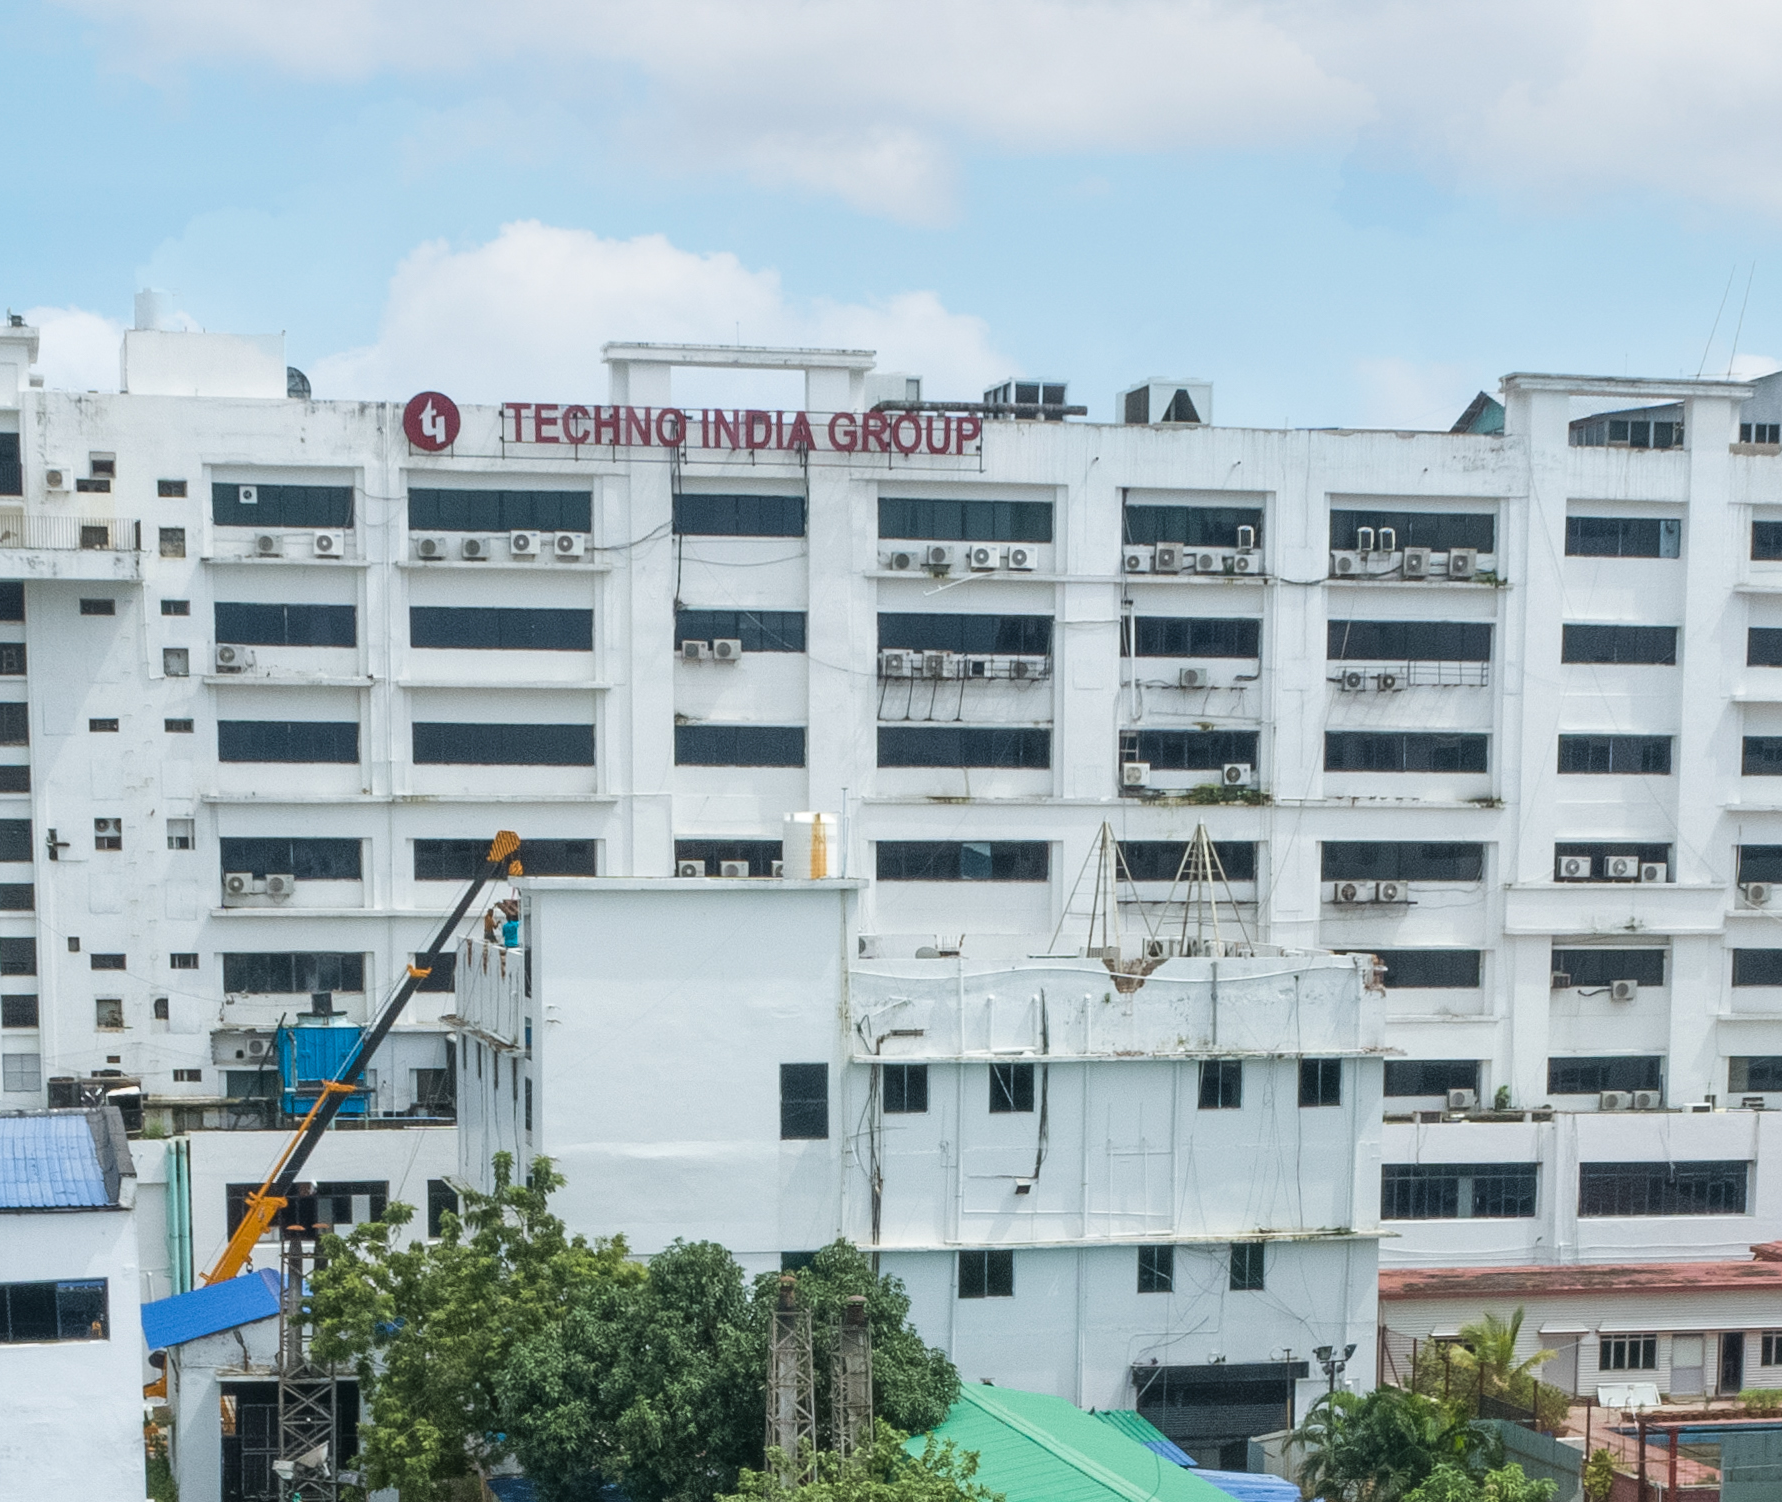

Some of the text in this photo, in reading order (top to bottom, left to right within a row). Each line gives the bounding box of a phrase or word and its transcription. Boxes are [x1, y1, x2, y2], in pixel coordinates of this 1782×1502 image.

[504, 402, 982, 455] TECHNO INDIA GROUP
